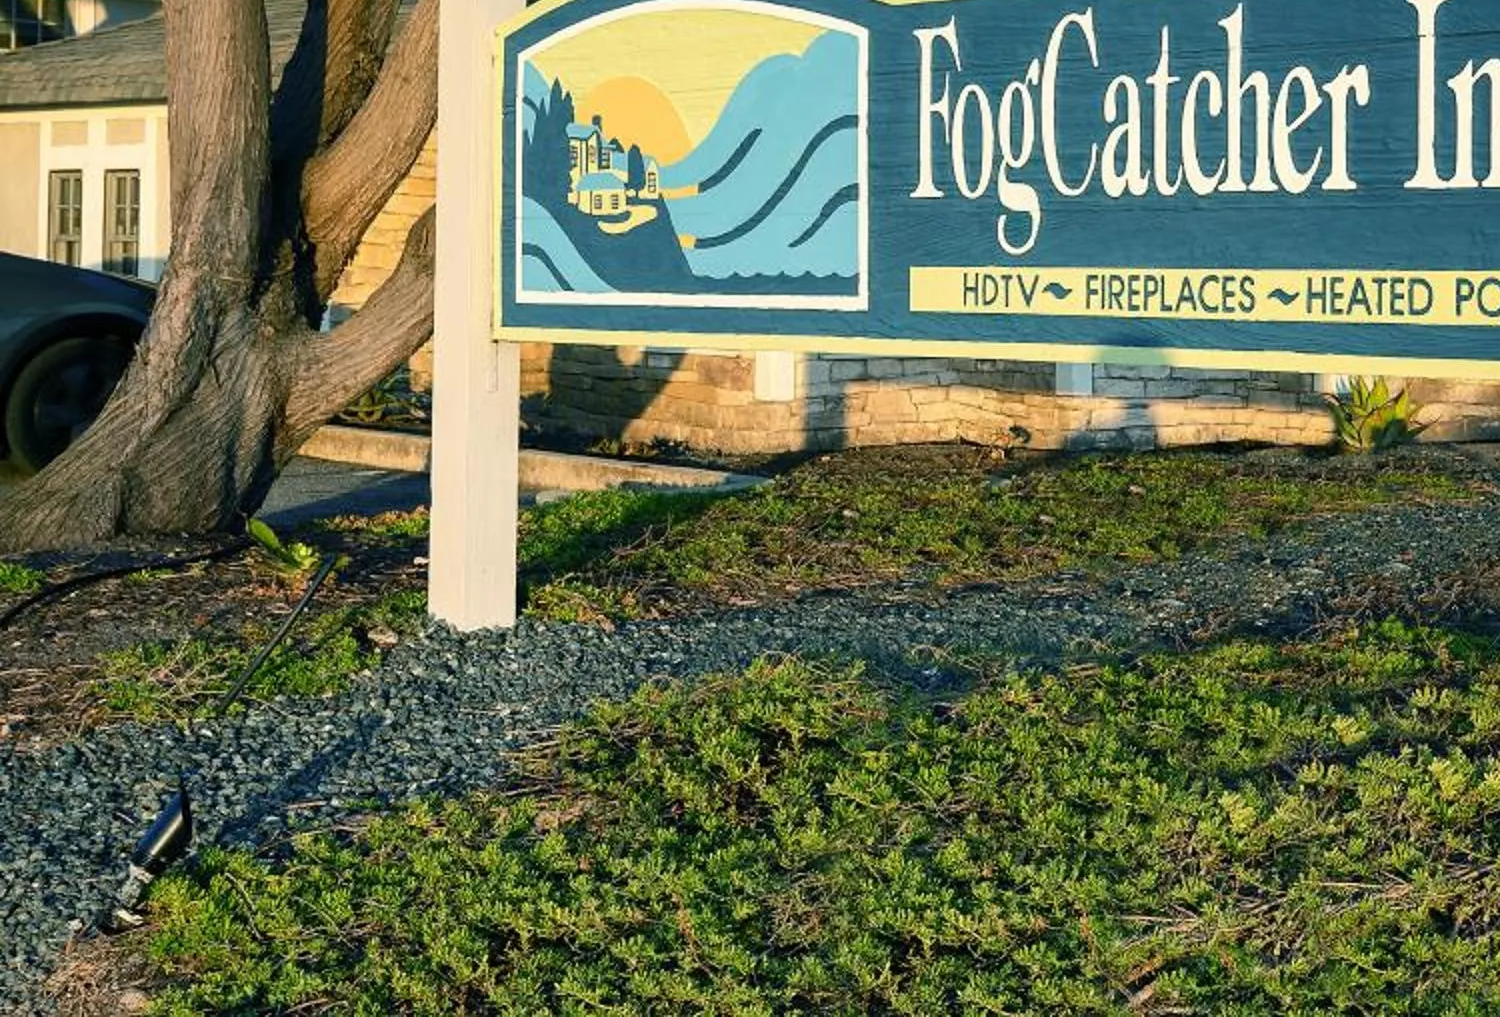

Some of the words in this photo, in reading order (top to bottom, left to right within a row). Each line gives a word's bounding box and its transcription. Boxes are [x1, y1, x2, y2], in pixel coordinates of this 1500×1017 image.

[909, 2, 1370, 255] FogCatcher
[962, 273, 1039, 308] HDTV
[1085, 274, 1256, 313] FIREPLACES
[1306, 277, 1434, 316] HEATED
